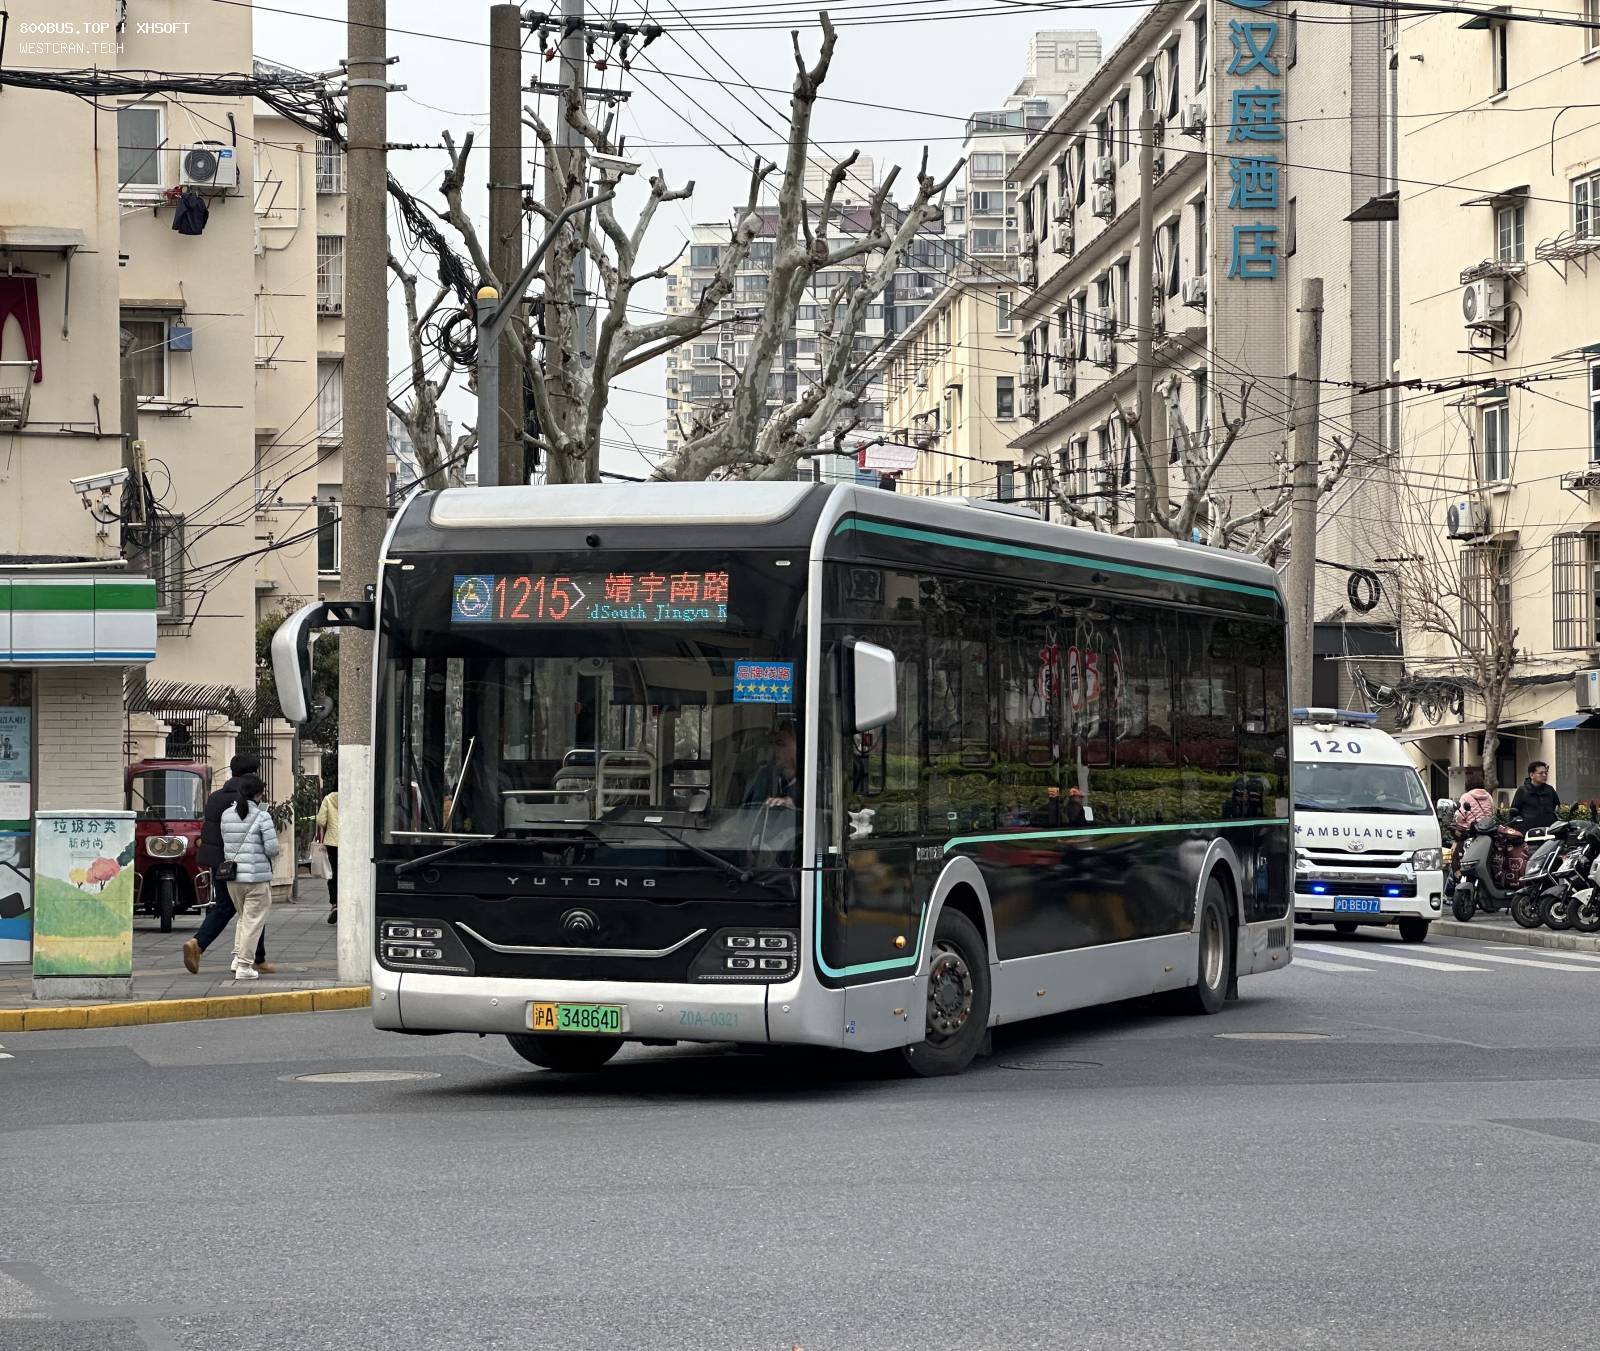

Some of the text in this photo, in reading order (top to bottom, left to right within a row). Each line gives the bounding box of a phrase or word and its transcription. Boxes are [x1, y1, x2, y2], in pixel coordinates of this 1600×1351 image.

[1226, 18, 1283, 280] 汉庭酒店
[604, 571, 729, 603] 靖宇南路
[496, 576, 570, 620] 1215
[654, 603, 709, 622] Jingyu
[736, 665, 791, 681] 品牌线路
[1310, 740, 1362, 754] 120
[53, 819, 117, 834] 垃圾分类
[1306, 827, 1403, 840] AMBULANCE
[68, 837, 104, 850] 新时尚
[507, 876, 656, 887] YUTONG
